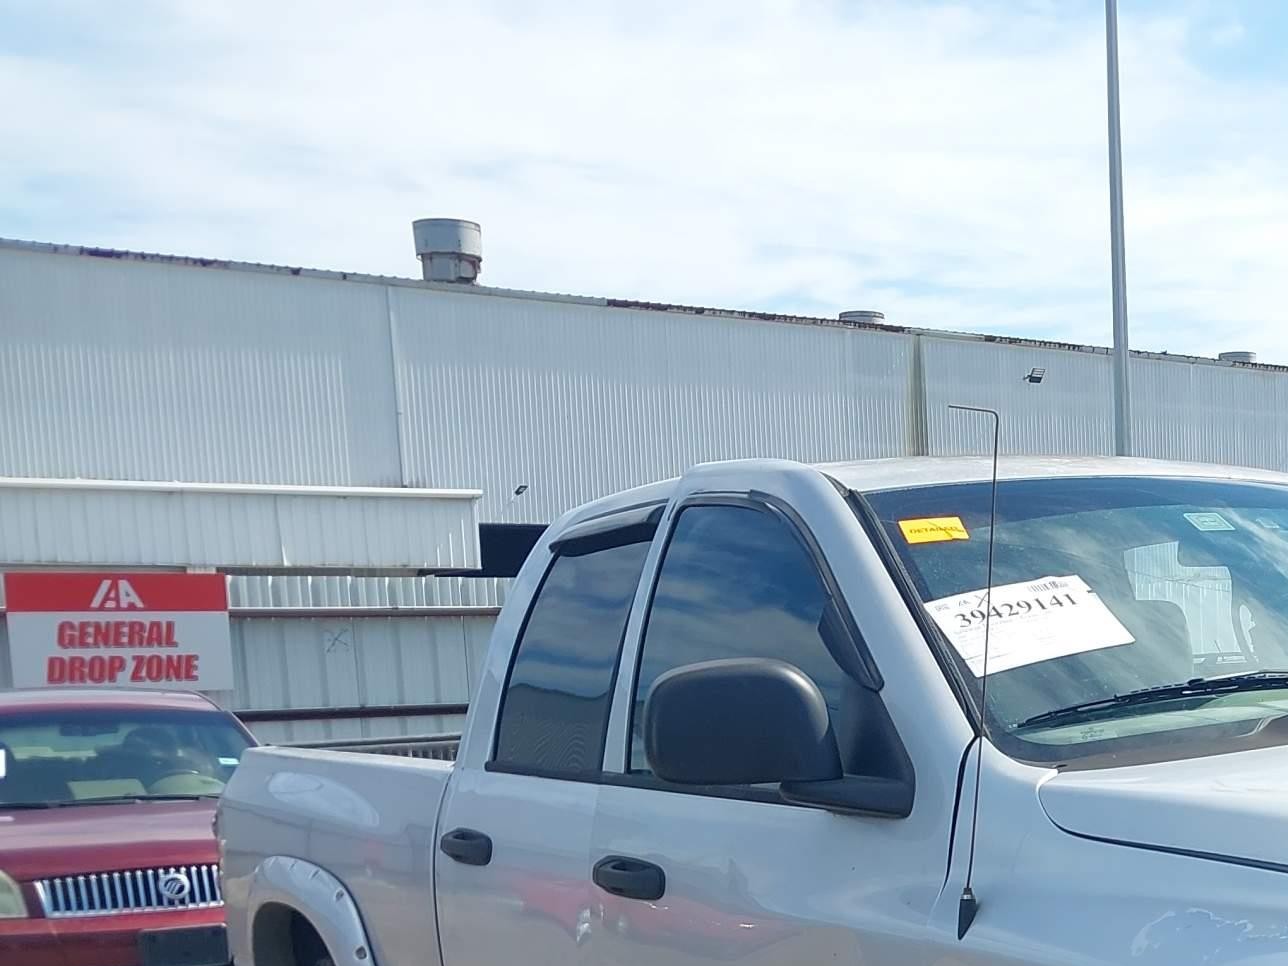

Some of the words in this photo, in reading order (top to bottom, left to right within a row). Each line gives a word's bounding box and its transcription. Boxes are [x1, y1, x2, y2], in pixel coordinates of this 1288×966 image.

[955, 593, 1079, 628] 39429141
[57, 620, 179, 649] GENERAL
[47, 655, 126, 685] DROP
[130, 654, 199, 683] ZONE
